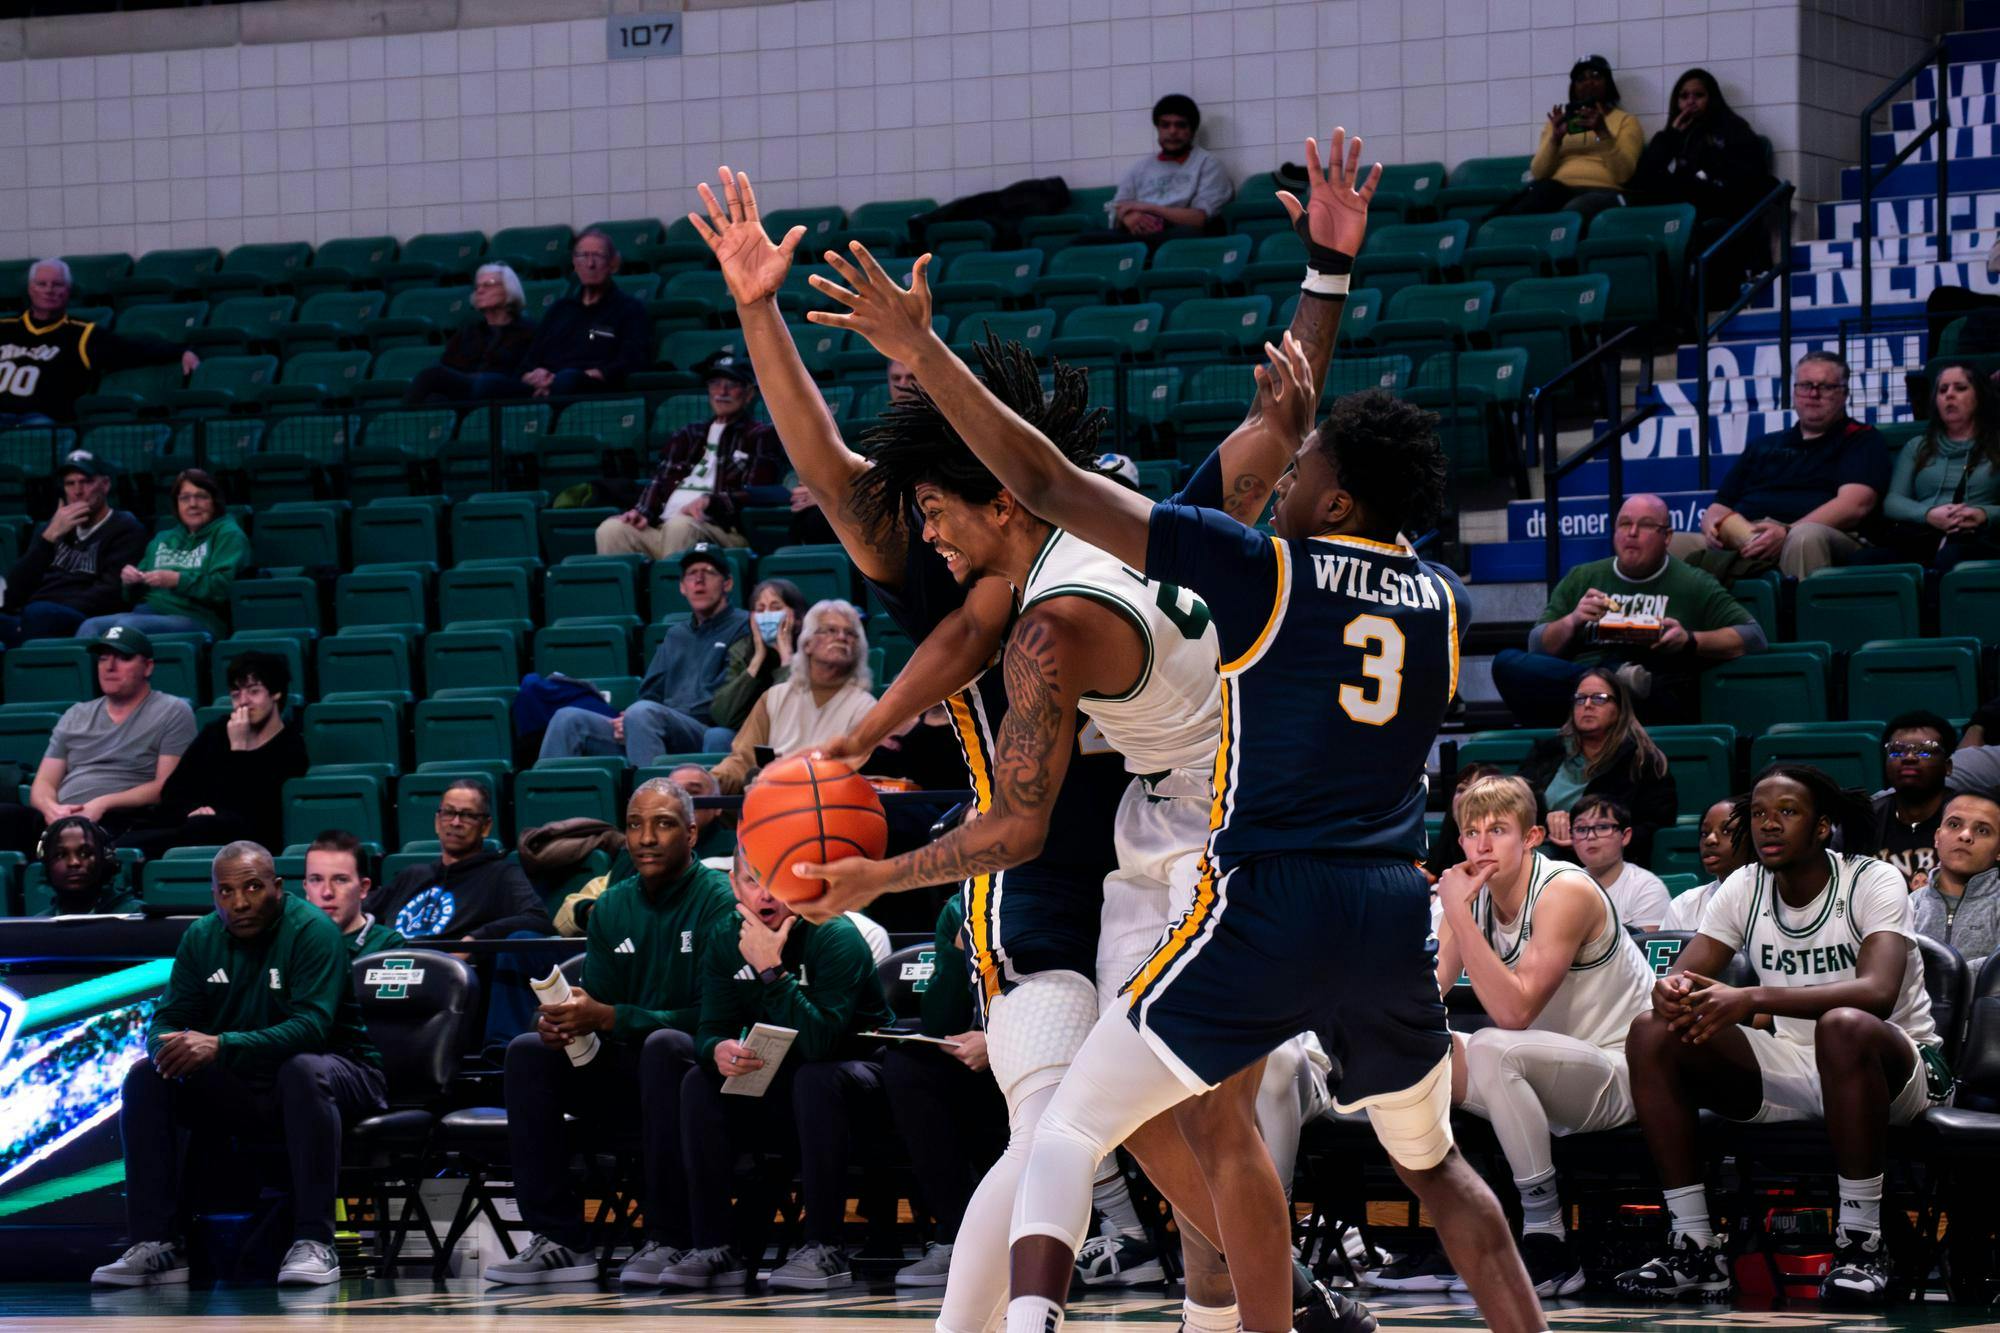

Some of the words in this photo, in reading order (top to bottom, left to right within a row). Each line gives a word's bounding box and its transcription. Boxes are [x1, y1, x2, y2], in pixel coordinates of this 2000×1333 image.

[620, 23, 673, 48] 107
[1310, 553, 1440, 611] WILSON
[1338, 613, 1406, 727] 3
